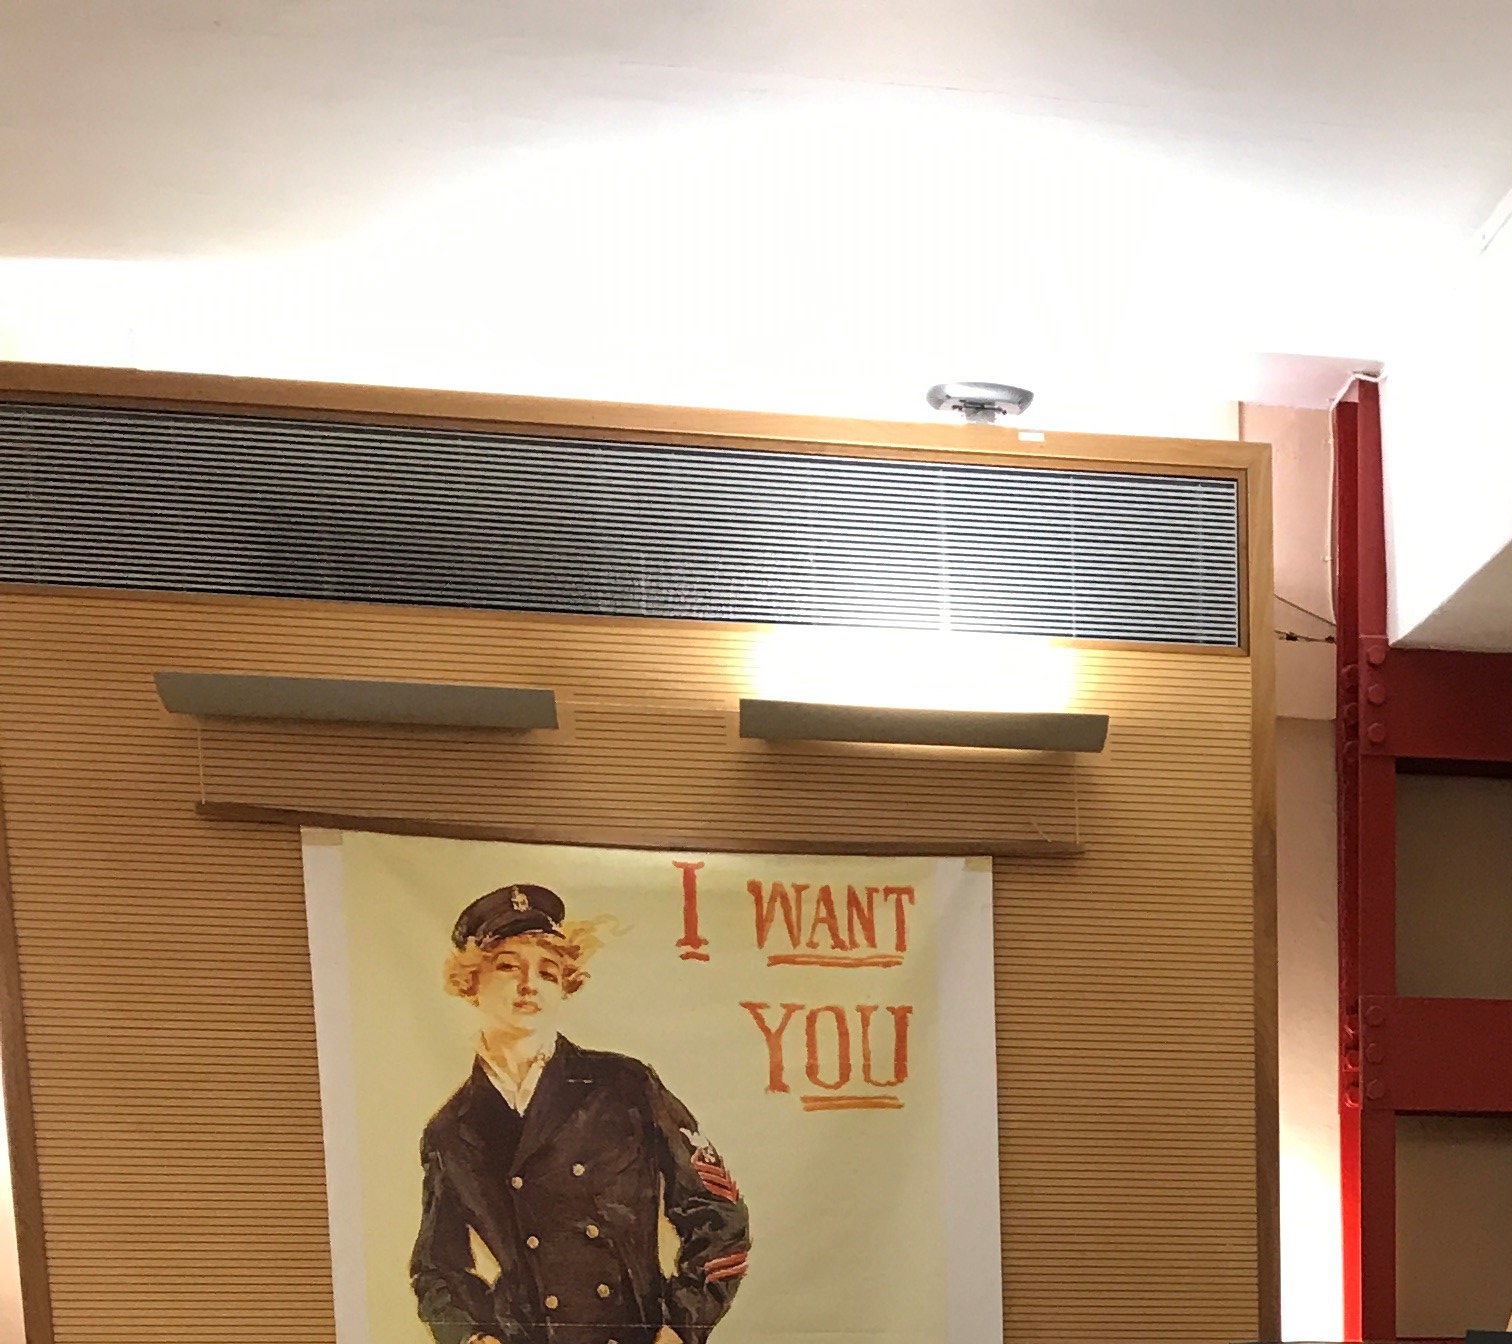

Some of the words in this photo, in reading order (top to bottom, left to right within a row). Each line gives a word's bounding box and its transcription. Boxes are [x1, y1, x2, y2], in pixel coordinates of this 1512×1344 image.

[672, 861, 710, 949] I
[747, 880, 917, 953] WANT
[739, 1000, 914, 1093] YOU
